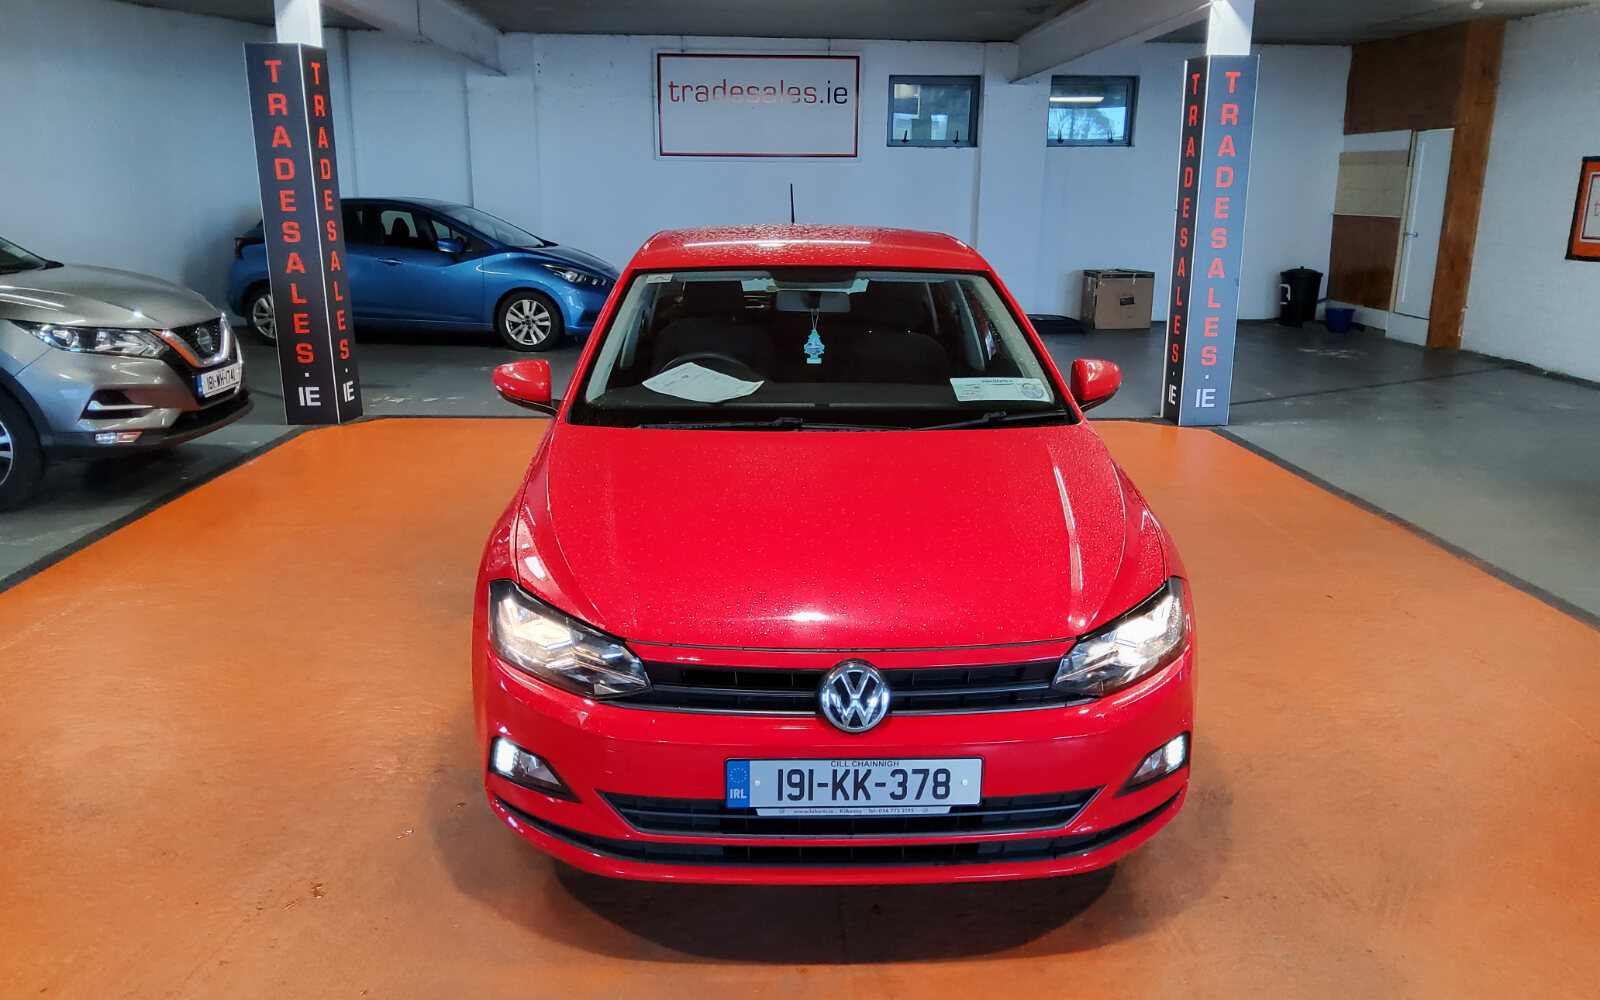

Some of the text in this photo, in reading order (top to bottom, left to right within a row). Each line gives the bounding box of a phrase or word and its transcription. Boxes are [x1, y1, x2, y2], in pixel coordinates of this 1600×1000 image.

[668, 78, 848, 104] tradesales.ie
[729, 788, 747, 799] IRL
[777, 768, 951, 801] 191-KK-378
